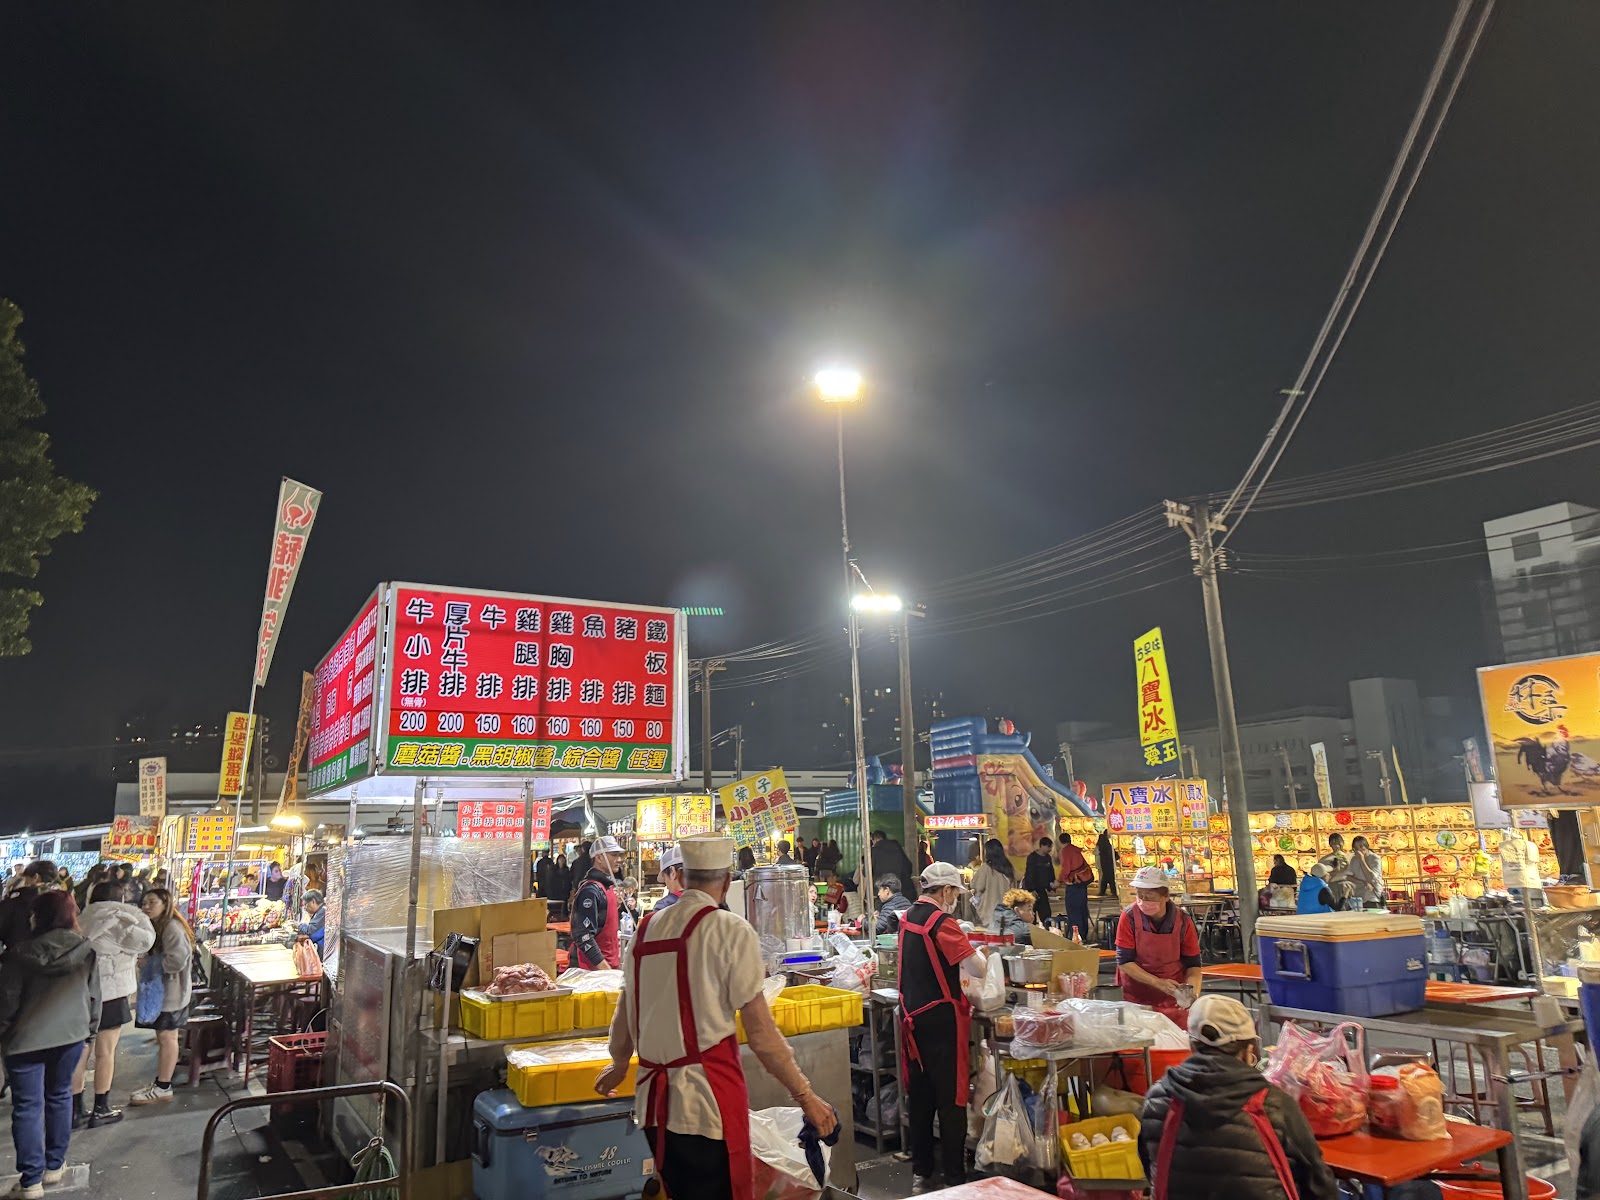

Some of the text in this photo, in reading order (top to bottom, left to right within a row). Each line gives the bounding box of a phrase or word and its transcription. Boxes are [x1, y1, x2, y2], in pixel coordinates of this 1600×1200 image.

[401, 598, 433, 695] 牛小排
[438, 602, 470, 697] 厚片牛排
[476, 605, 506, 699] 牛排
[513, 607, 540, 700] 雞腿排
[547, 611, 574, 702] 雞胸排
[580, 614, 606, 704] 魚排
[612, 617, 638, 706] 豬排
[643, 620, 668, 707] 鐵板麵
[400, 711, 663, 739] 200 200 150 160 160 160 150 80
[1141, 656, 1166, 734] 八寶冰
[626, 747, 668, 770] 任選
[1144, 741, 1178, 767] 愛玉
[1180, 784, 1204, 801] 八寶冰
[1108, 784, 1173, 807] 八寶冰
[1109, 813, 1124, 829] 熱
[600, 1145, 618, 1160] 48
